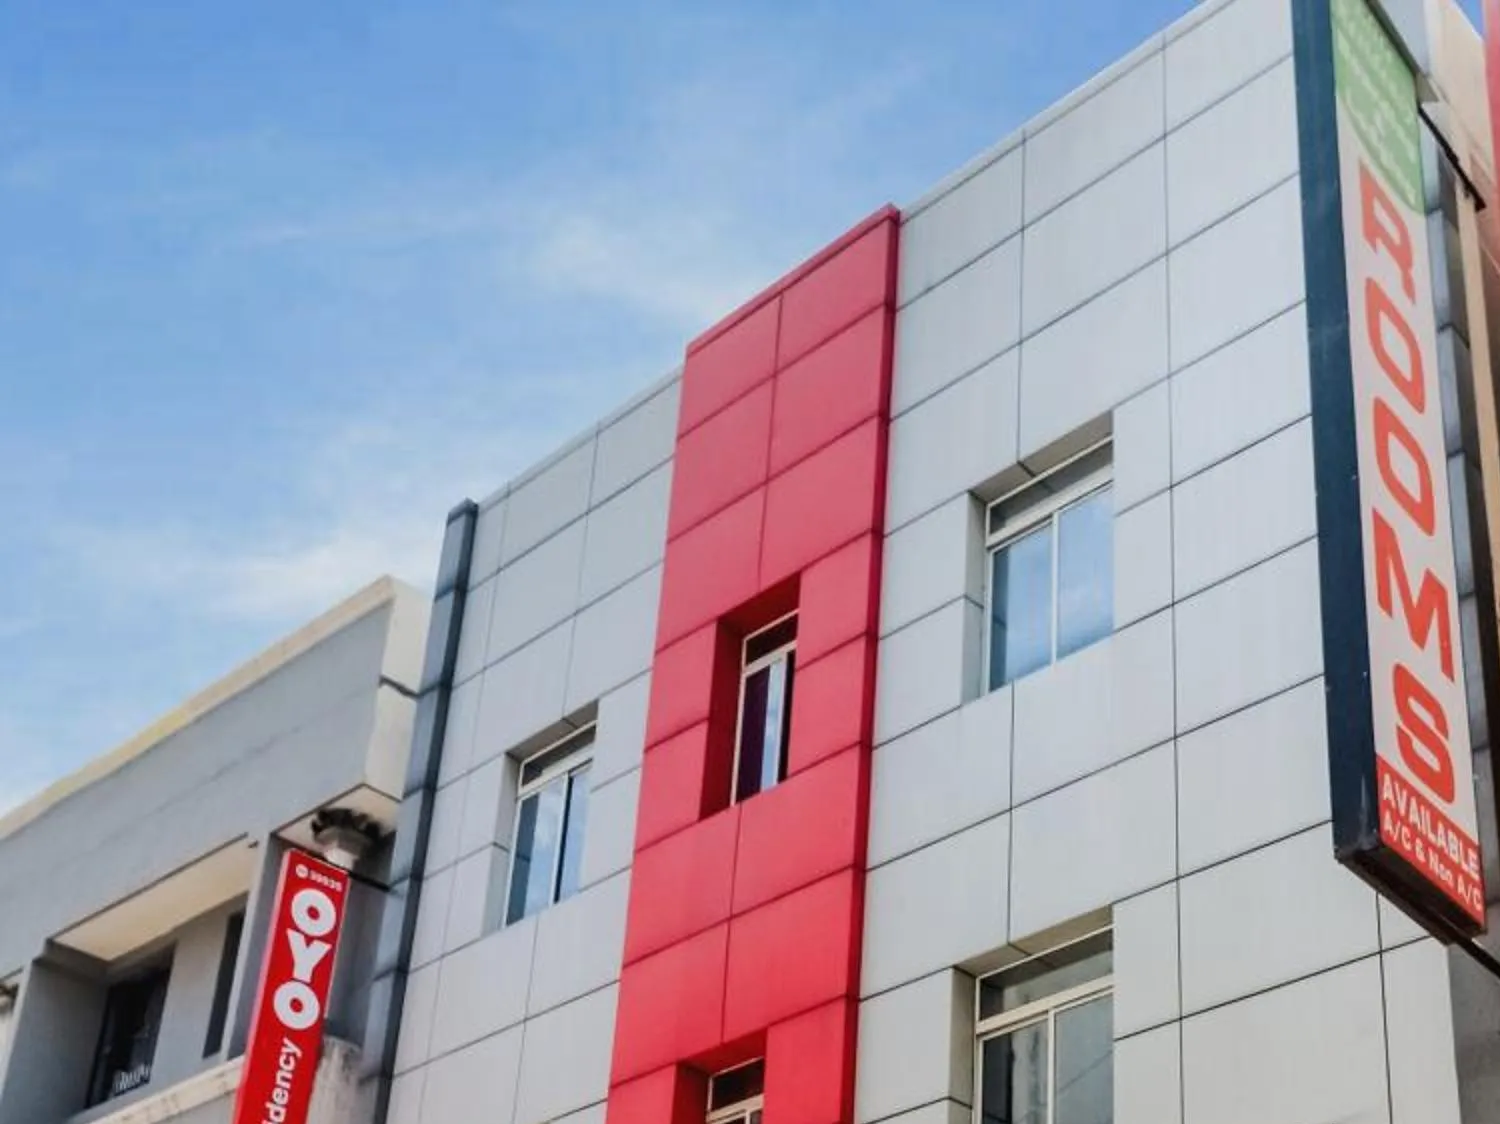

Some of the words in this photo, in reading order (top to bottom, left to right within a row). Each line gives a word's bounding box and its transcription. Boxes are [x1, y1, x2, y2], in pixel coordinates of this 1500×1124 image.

[1360, 162, 1456, 804] ROOMS
[1383, 772, 1481, 882] AVAILABLE
[1383, 811, 1412, 851] A/C
[1429, 848, 1455, 887] Non
[1457, 875, 1483, 911] A/C
[273, 887, 337, 1030] OYO
